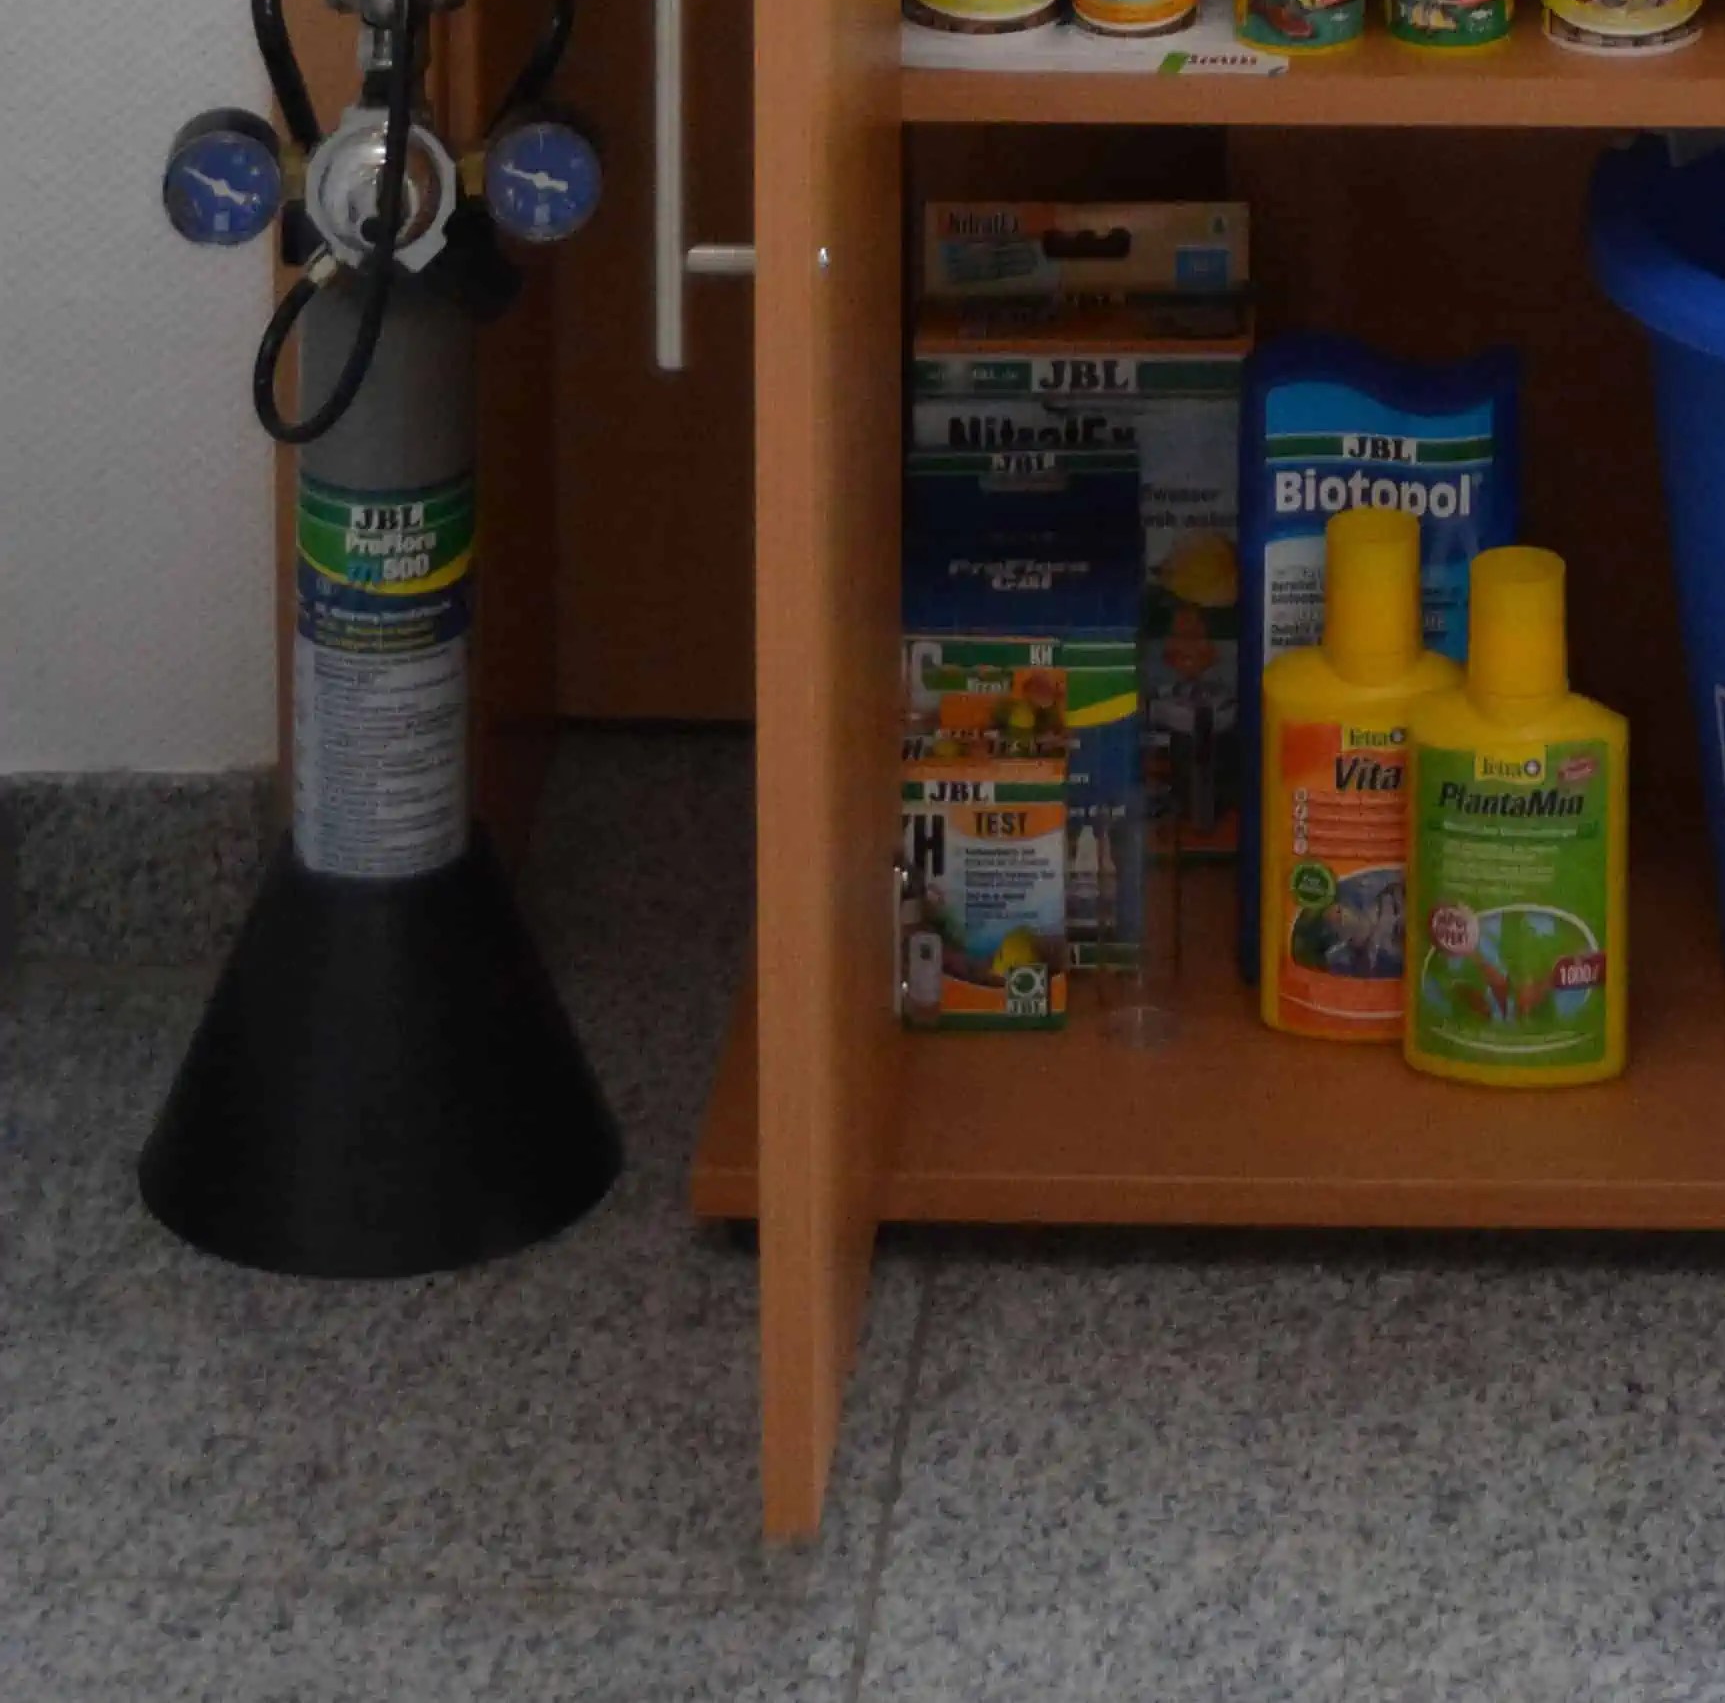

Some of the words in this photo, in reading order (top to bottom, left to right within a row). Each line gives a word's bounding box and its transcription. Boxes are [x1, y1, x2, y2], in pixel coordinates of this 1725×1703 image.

[1040, 360, 1128, 390] JBL
[1348, 437, 1412, 461] JBL
[1275, 468, 1471, 518] Biotopol
[355, 505, 421, 530] JBL
[1335, 756, 1405, 792] Vita
[972, 811, 1028, 837] TEST
